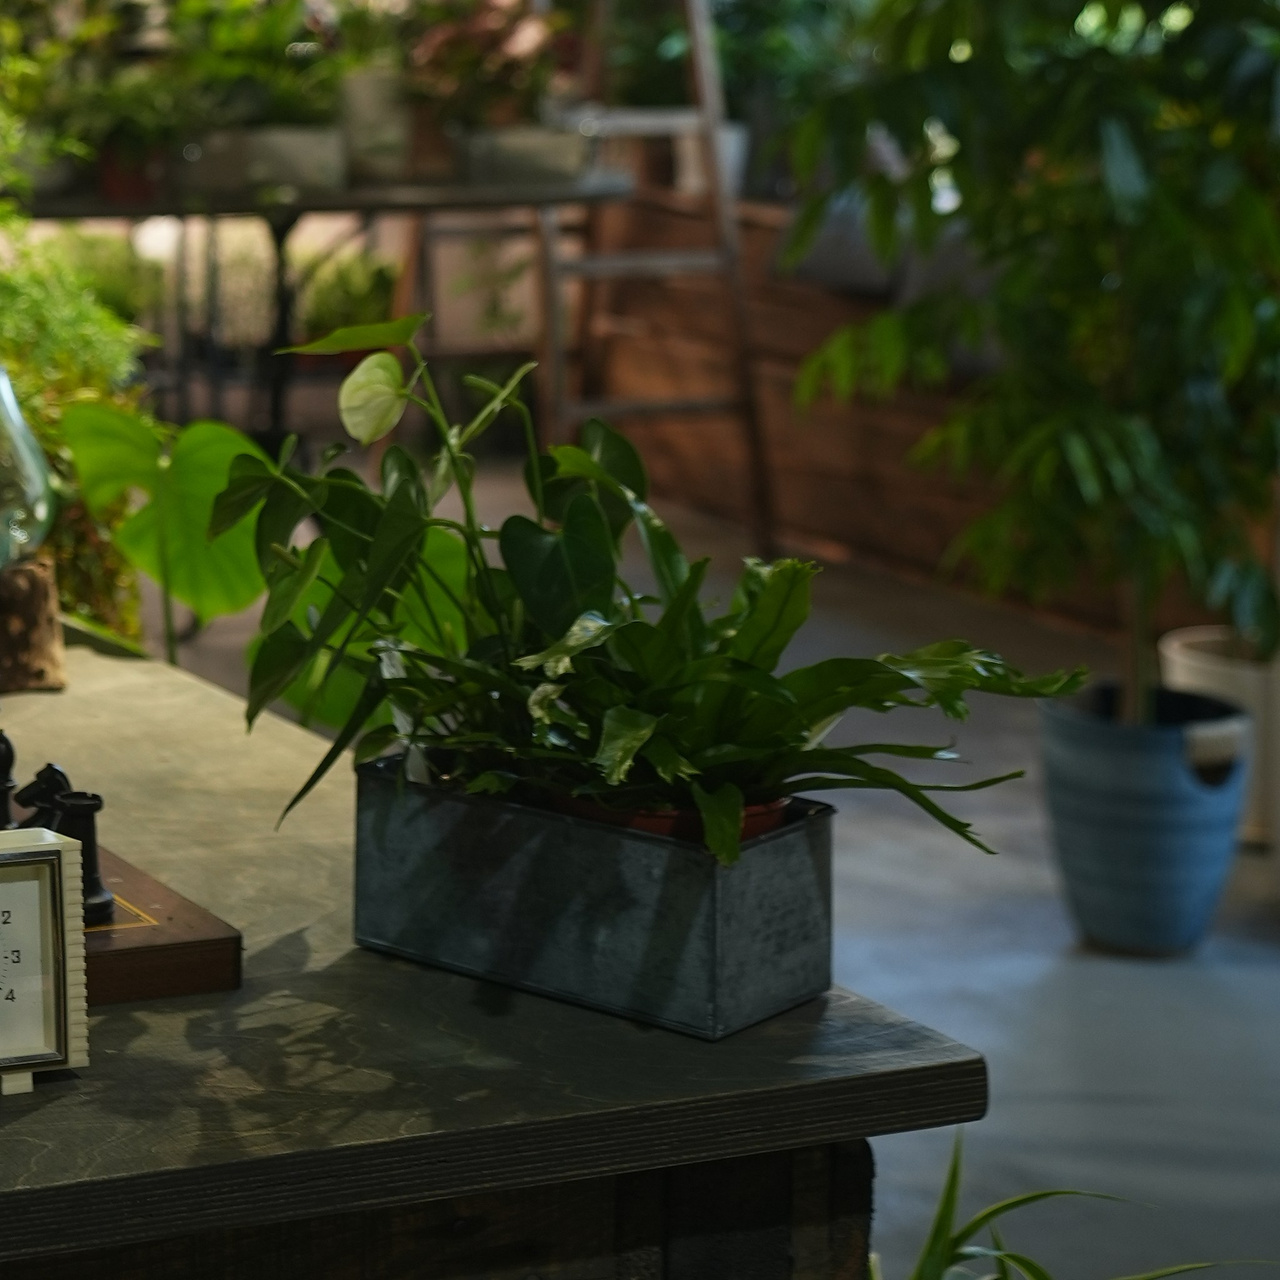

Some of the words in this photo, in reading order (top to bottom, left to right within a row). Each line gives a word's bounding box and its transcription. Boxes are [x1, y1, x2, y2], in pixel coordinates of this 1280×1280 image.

[1, 910, 11, 924] 2
[11, 949, 20, 964] 3
[5, 989, 16, 1002] 4
